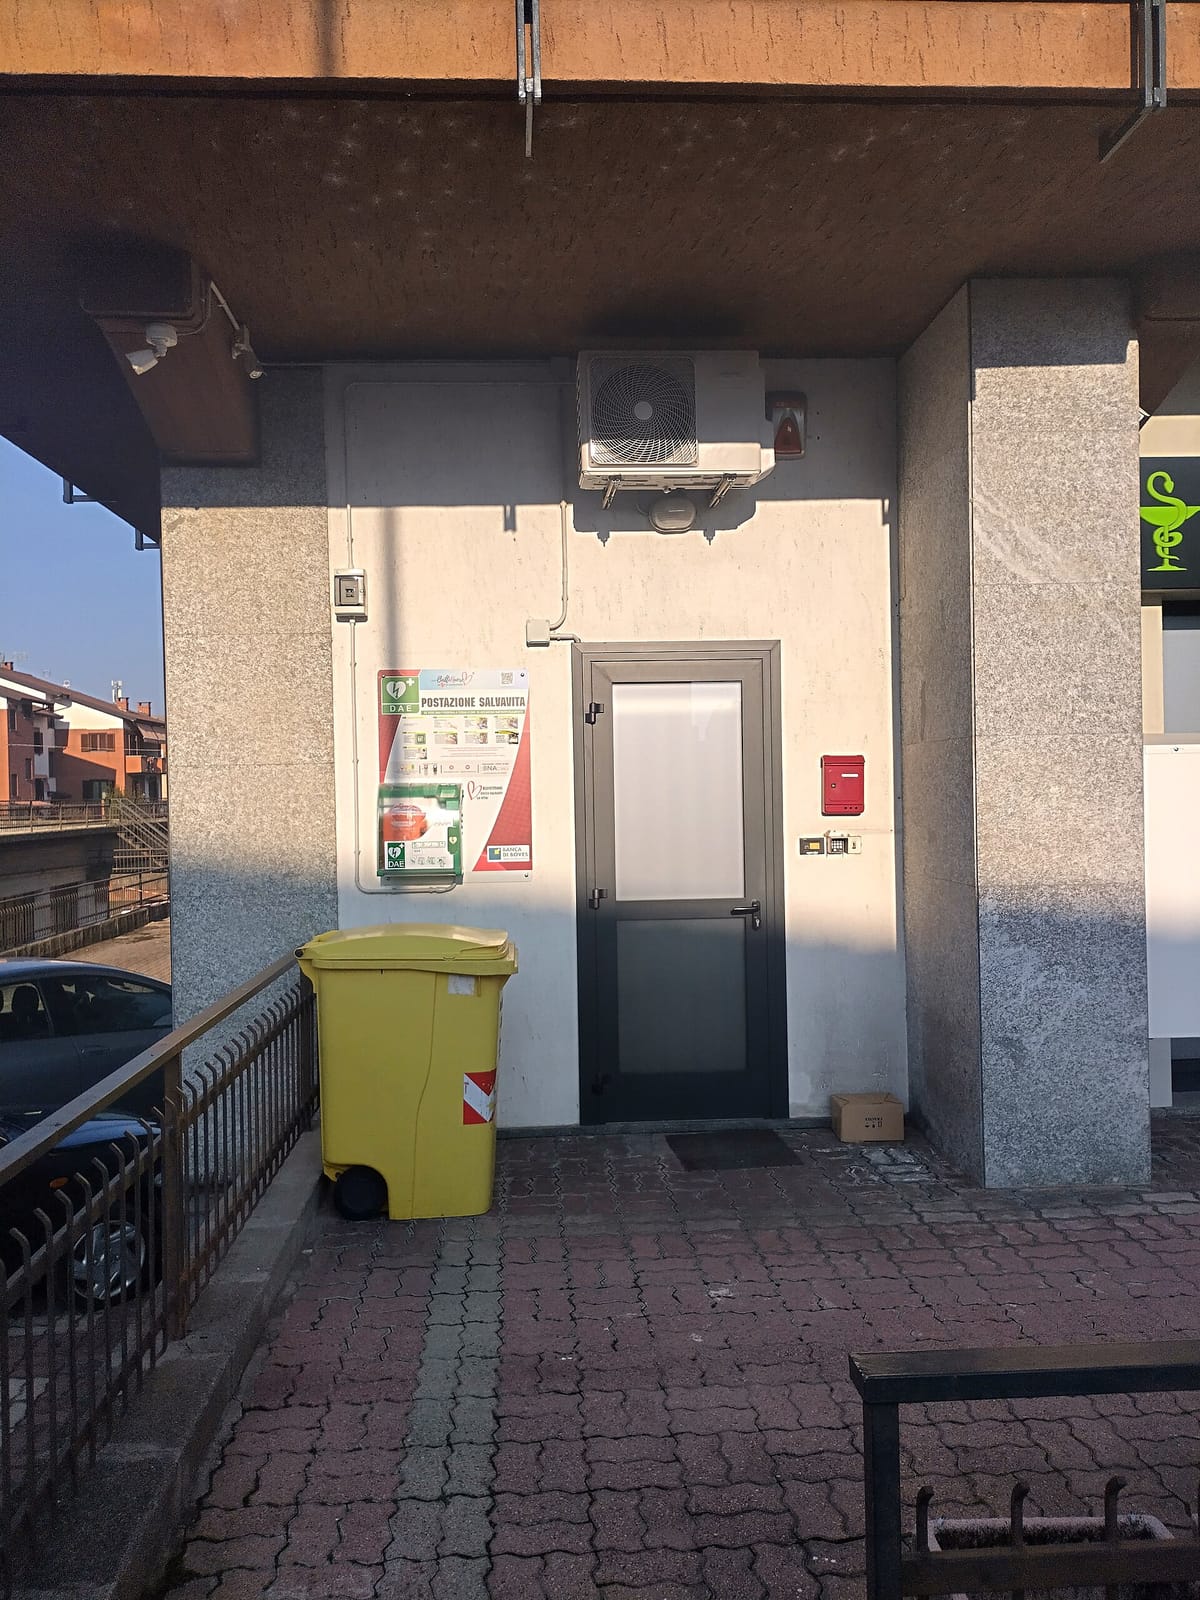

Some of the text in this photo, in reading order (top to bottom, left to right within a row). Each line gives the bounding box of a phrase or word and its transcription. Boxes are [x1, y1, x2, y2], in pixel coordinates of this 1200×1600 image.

[421, 696, 526, 708] POSTAZIONE SALVAVITA
[389, 704, 413, 713] DAE
[388, 860, 405, 868] DAE
